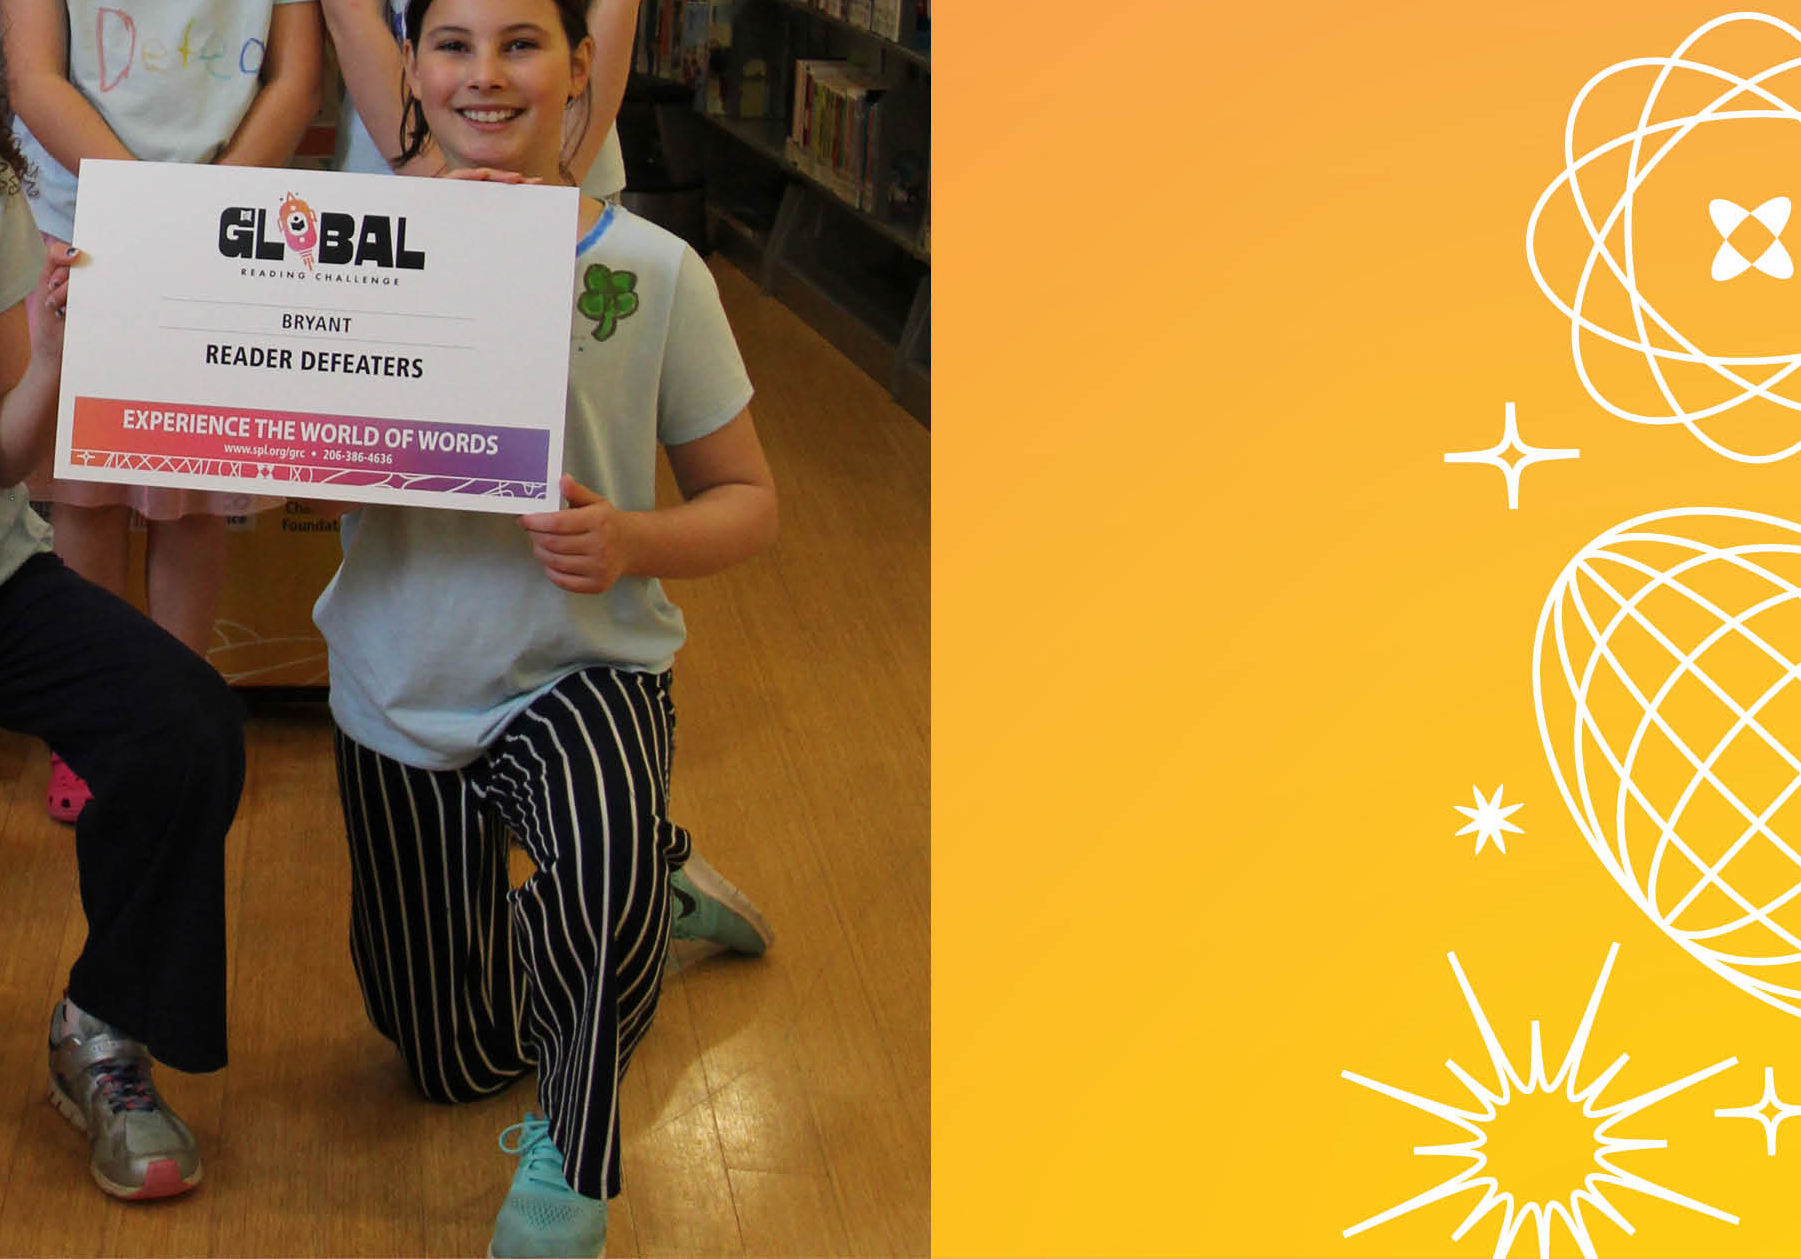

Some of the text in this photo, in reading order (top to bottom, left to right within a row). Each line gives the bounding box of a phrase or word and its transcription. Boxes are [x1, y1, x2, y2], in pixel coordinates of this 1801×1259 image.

[241, 268, 399, 286] READING CHALLENGE
[282, 313, 352, 333] BRYANT
[205, 344, 424, 379] READER DEFEATERS
[123, 409, 499, 455] EXPERIENCE THE WORLD OF WORDS
[224, 444, 393, 464] www.spl.org/grc 206-386-4636
[282, 518, 337, 532] Foundat
